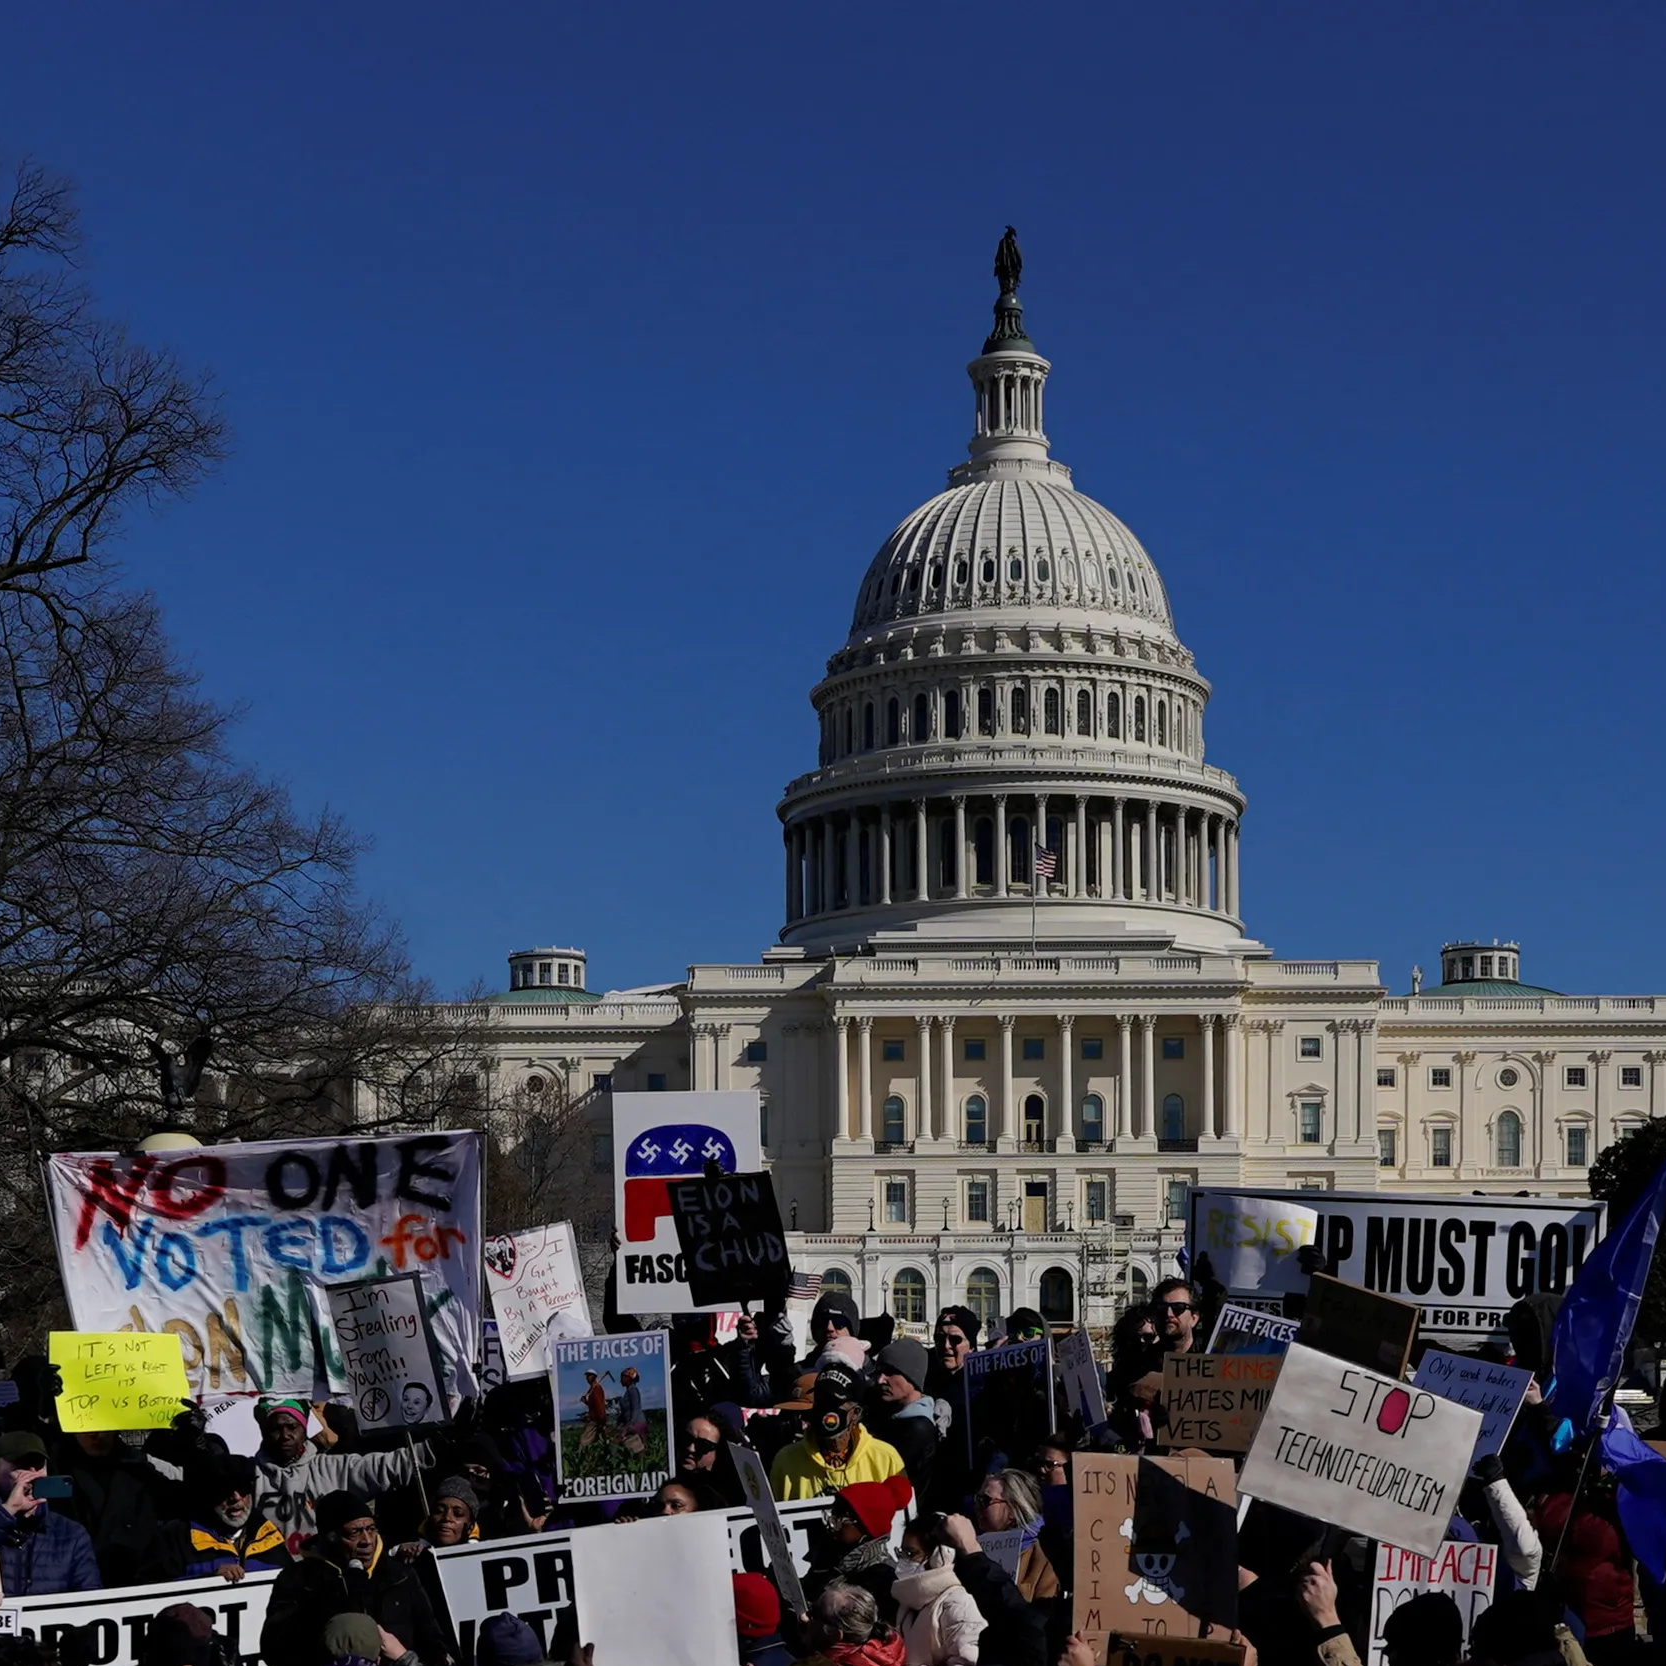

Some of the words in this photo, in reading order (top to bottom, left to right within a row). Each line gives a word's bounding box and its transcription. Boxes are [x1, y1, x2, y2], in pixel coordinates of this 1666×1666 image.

[76, 1152, 227, 1251] NO
[265, 1136, 455, 1210] ONE
[686, 1212, 712, 1238] IS
[722, 1212, 741, 1232] A
[1208, 1209, 1312, 1256] RESIST
[101, 1215, 371, 1292] VOTED
[380, 1214, 466, 1268] for
[546, 1239, 563, 1257] I
[695, 1232, 782, 1272] CHUD
[1365, 1216, 1496, 1297] MUST
[531, 1265, 555, 1279] Got
[337, 1287, 389, 1313] I'm
[516, 1280, 559, 1299] Bought
[504, 1306, 524, 1321] By
[528, 1301, 537, 1311] A
[1433, 1311, 1469, 1325] FOR
[336, 1310, 417, 1341] Stealing
[1223, 1310, 1253, 1332] THE
[1252, 1318, 1297, 1343] FACES
[78, 1341, 115, 1359] IT'S
[125, 1340, 151, 1352] NOT
[509, 1320, 546, 1364] Humanity
[557, 1343, 588, 1363] THE
[592, 1338, 639, 1358] FACES
[643, 1335, 664, 1356] OF
[85, 1363, 118, 1378] LEFT
[346, 1348, 390, 1368] From
[967, 1356, 991, 1376] THE
[992, 1350, 1027, 1371] FACES
[1029, 1344, 1047, 1363] OF
[1170, 1358, 1214, 1377] THE
[1222, 1358, 1277, 1380] KING
[1429, 1358, 1455, 1382] Only
[65, 1394, 99, 1413] TOP
[112, 1397, 129, 1408] VS
[1167, 1389, 1234, 1412] HATES
[1331, 1370, 1435, 1438] STOP
[1167, 1418, 1221, 1441] VETS
[1083, 1470, 1116, 1495] IT'S
[1204, 1477, 1218, 1497] A
[1275, 1426, 1446, 1515] TECHNOFEUDALISM
[563, 1475, 637, 1498] FOREIGN
[639, 1471, 667, 1491] AID
[1378, 1544, 1494, 1586] IMPEACH
